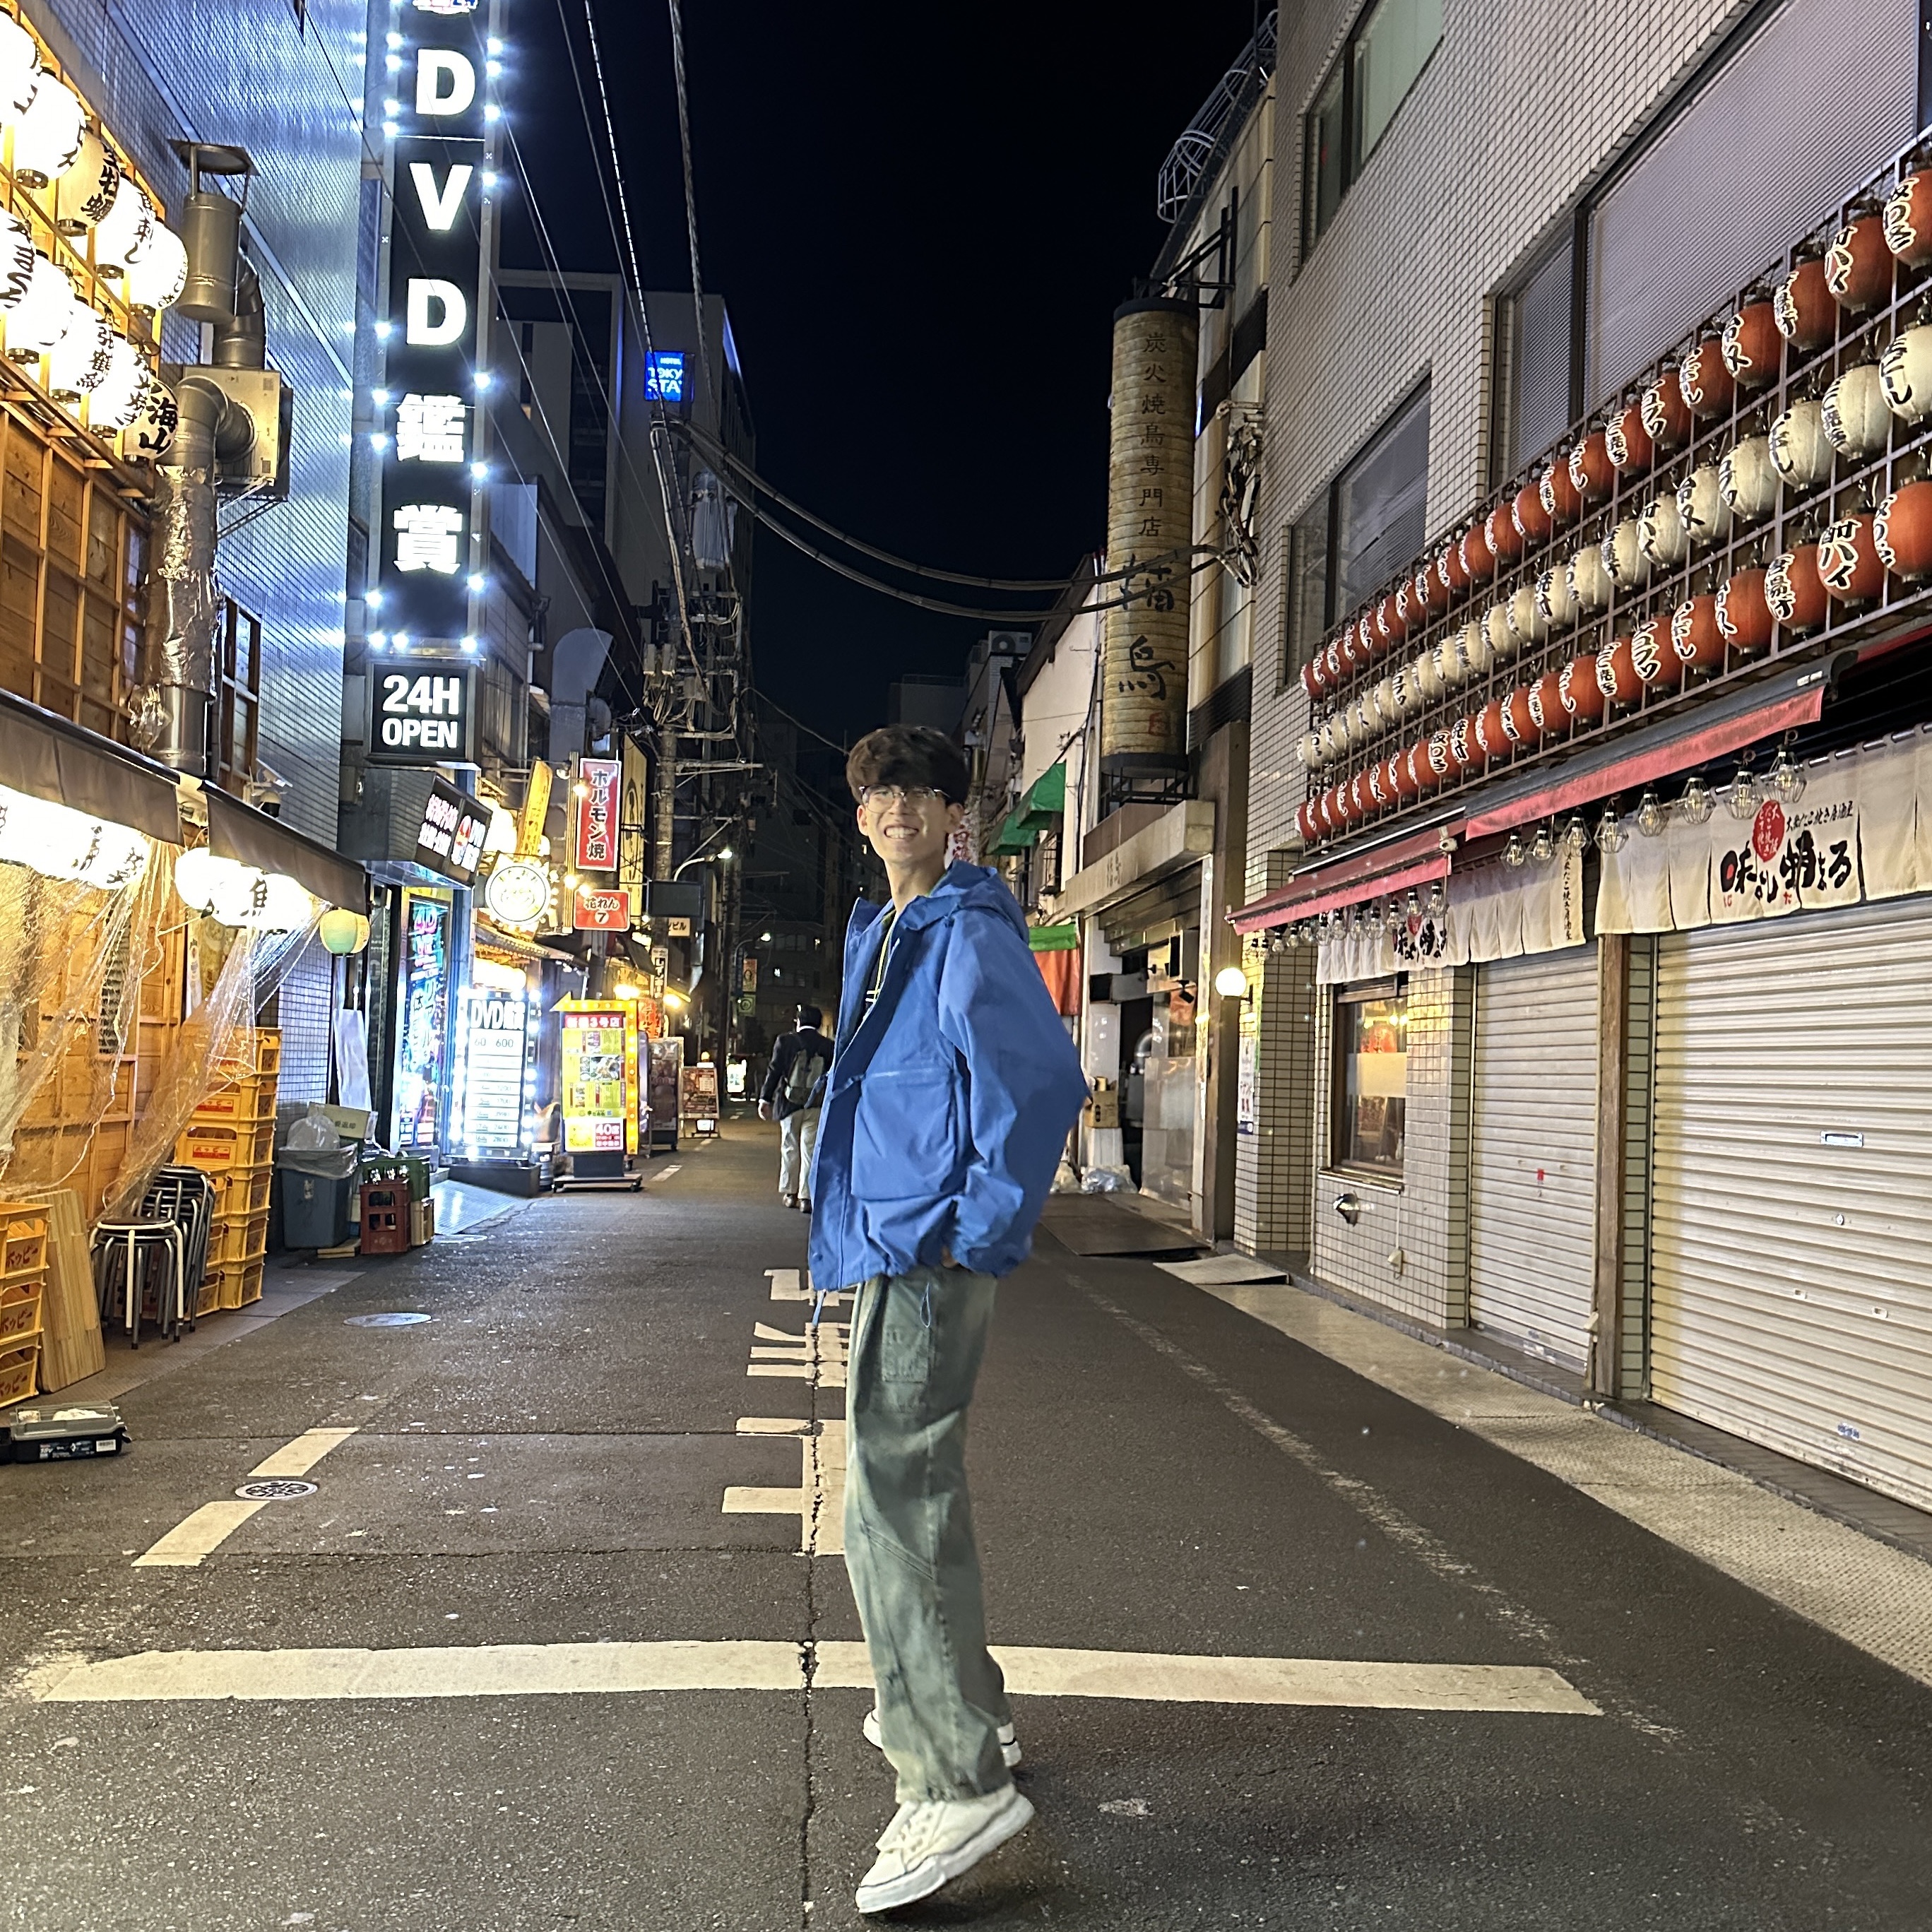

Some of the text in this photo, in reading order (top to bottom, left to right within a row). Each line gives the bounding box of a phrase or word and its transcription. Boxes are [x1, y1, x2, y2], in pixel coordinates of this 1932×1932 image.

[648, 379, 682, 393] STA
[1138, 332, 1167, 538] 炭火焼鳥専門店
[382, 675, 461, 714] 24H
[381, 718, 458, 749] OPEN
[588, 769, 609, 860] ホルモン焼
[585, 897, 620, 910] 花れん
[598, 913, 606, 925] 7
[495, 1038, 514, 1048] 600
